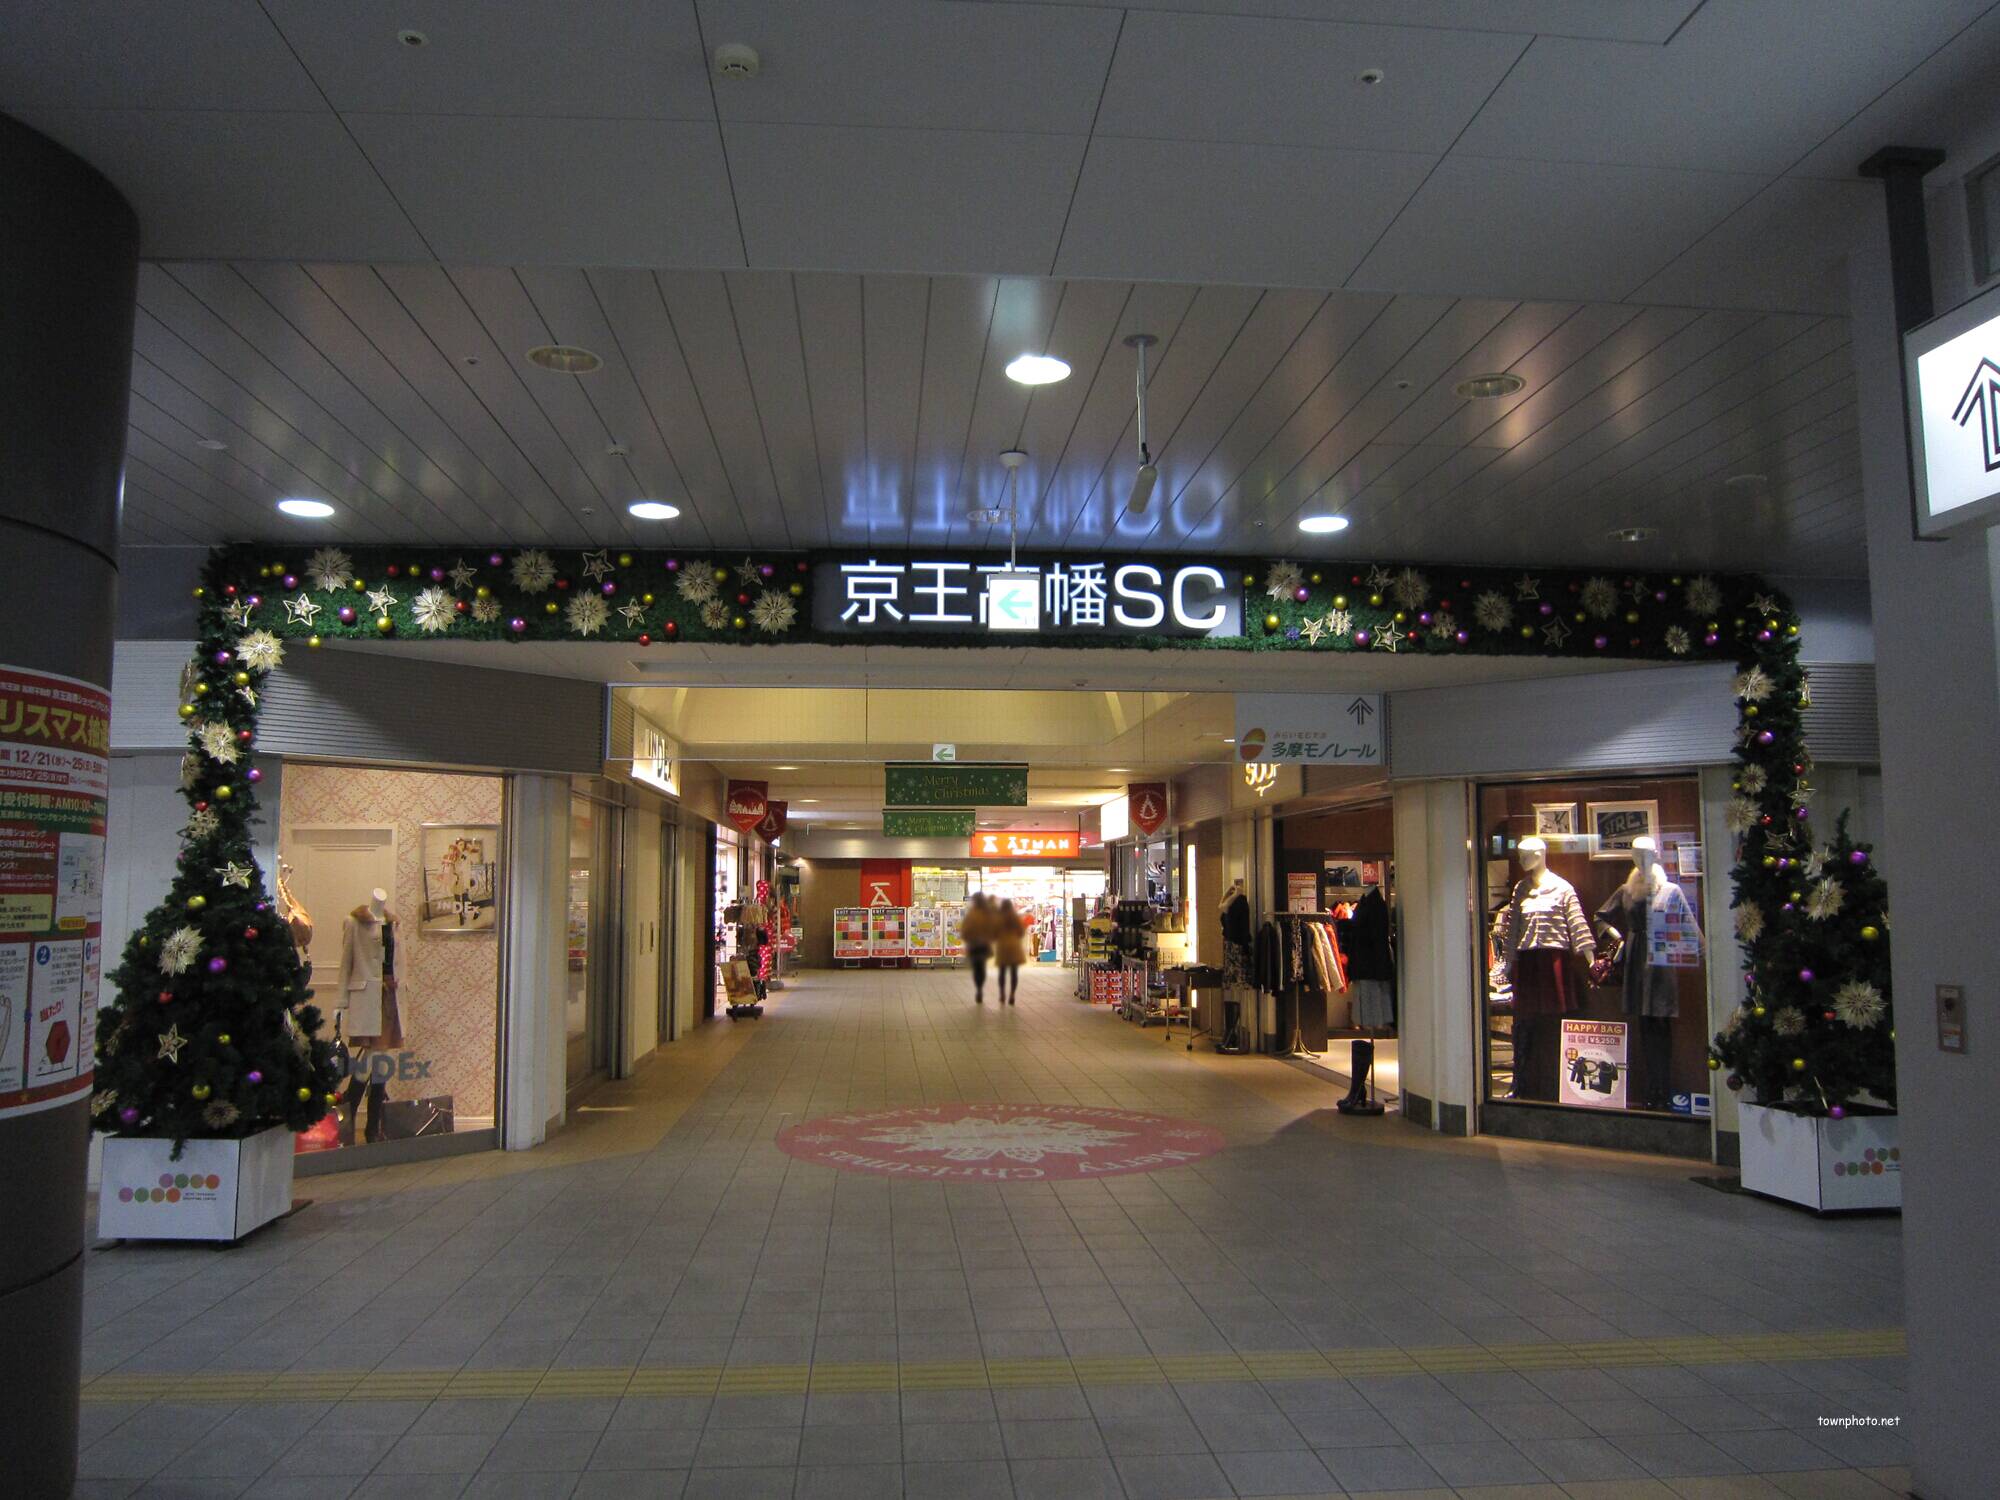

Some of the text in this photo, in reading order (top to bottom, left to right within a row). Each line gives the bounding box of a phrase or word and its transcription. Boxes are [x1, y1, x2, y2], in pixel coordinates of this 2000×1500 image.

[840, 559, 1227, 629] 京王幡SC
[1271, 741, 1377, 758] 多摩モノレール
[923, 775, 959, 786] Merry
[934, 786, 992, 801] Christmas
[1566, 1023, 1622, 1034] HAPPY BAG
